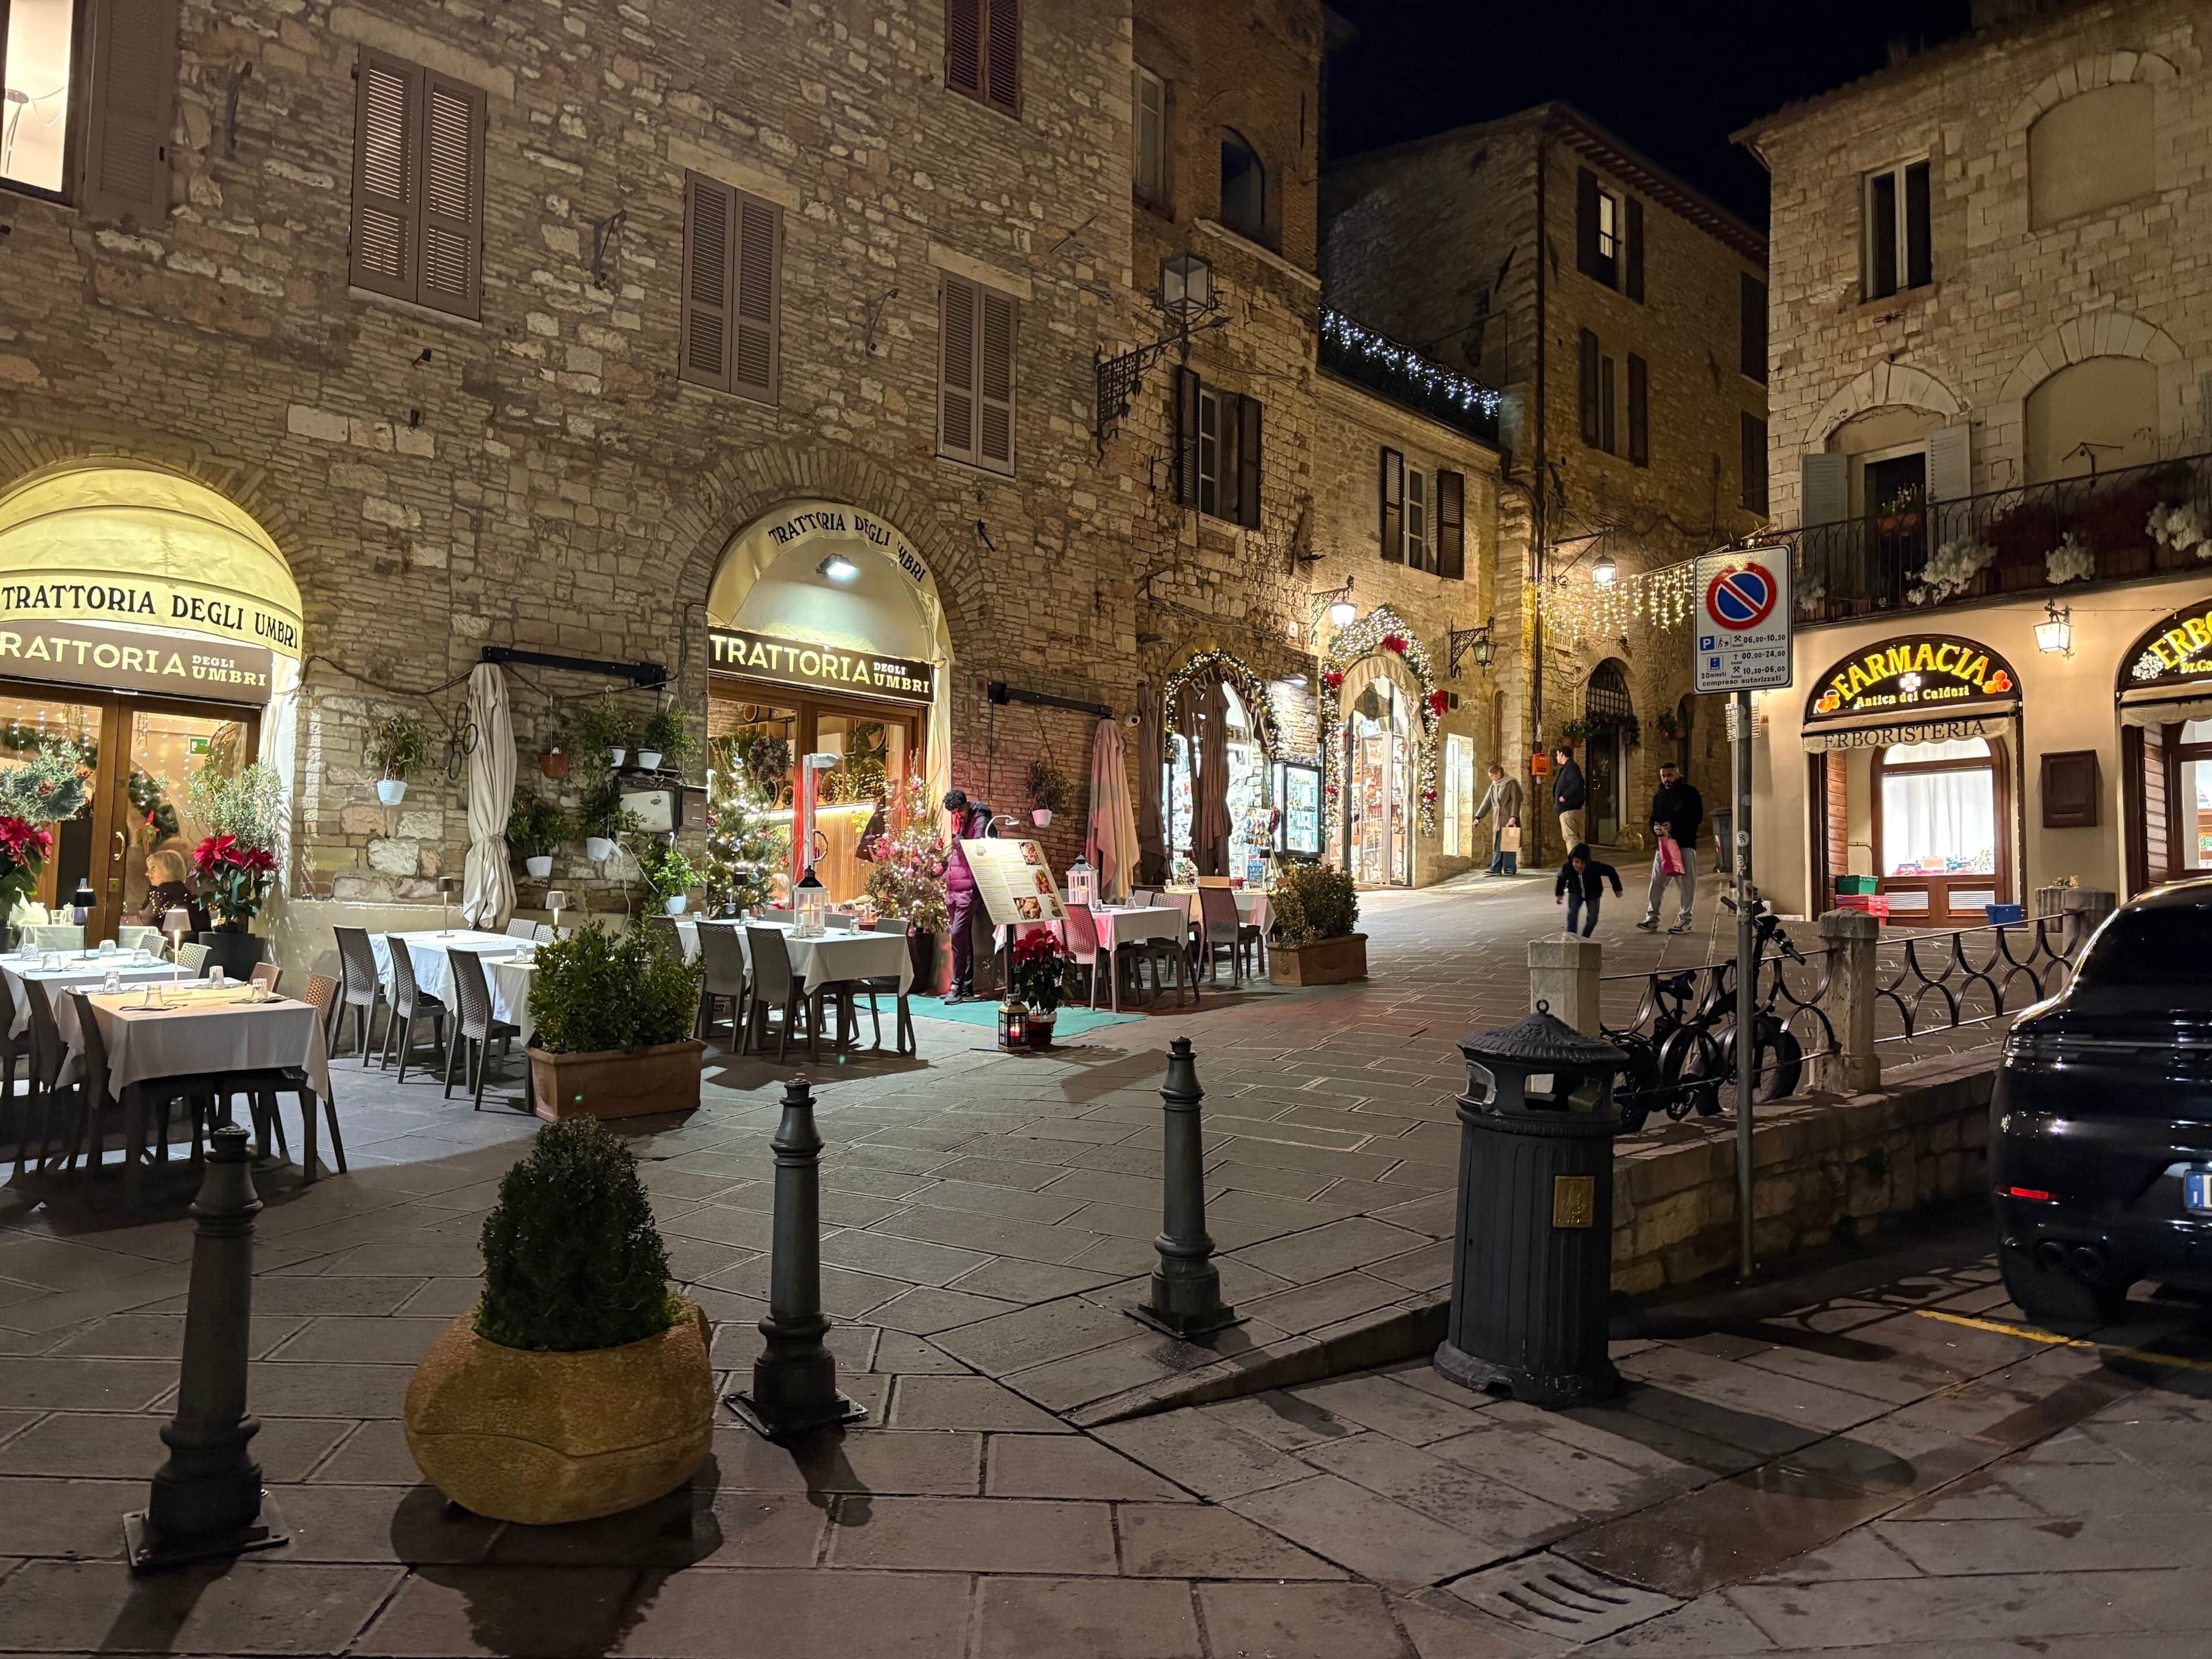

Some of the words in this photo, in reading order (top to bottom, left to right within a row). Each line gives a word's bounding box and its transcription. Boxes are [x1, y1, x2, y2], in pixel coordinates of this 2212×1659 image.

[768, 512, 846, 546] TRATTORIA
[854, 515, 892, 546] DEGLI
[1, 585, 156, 615] TRATTORIA
[171, 594, 244, 630] DEGLI
[255, 612, 298, 650] UMBRI
[1743, 634, 1786, 643] 06.00-10.30
[192, 654, 235, 669] DEGLI
[709, 635, 871, 685] TRATTORIA
[1741, 650, 1786, 660] 00.00-24.00
[192, 666, 267, 687] UMBRI
[873, 662, 907, 676] DEGLI
[1743, 666, 1786, 675] 10.30-06.00
[1831, 643, 1990, 701] FARMACIA
[873, 673, 930, 694] UMBRI
[1702, 679, 1738, 687] compreso
[1741, 675, 1782, 684] autorizzati
[1856, 696, 1897, 707] Antica
[1824, 719, 1987, 748] ERBORISTERIA
